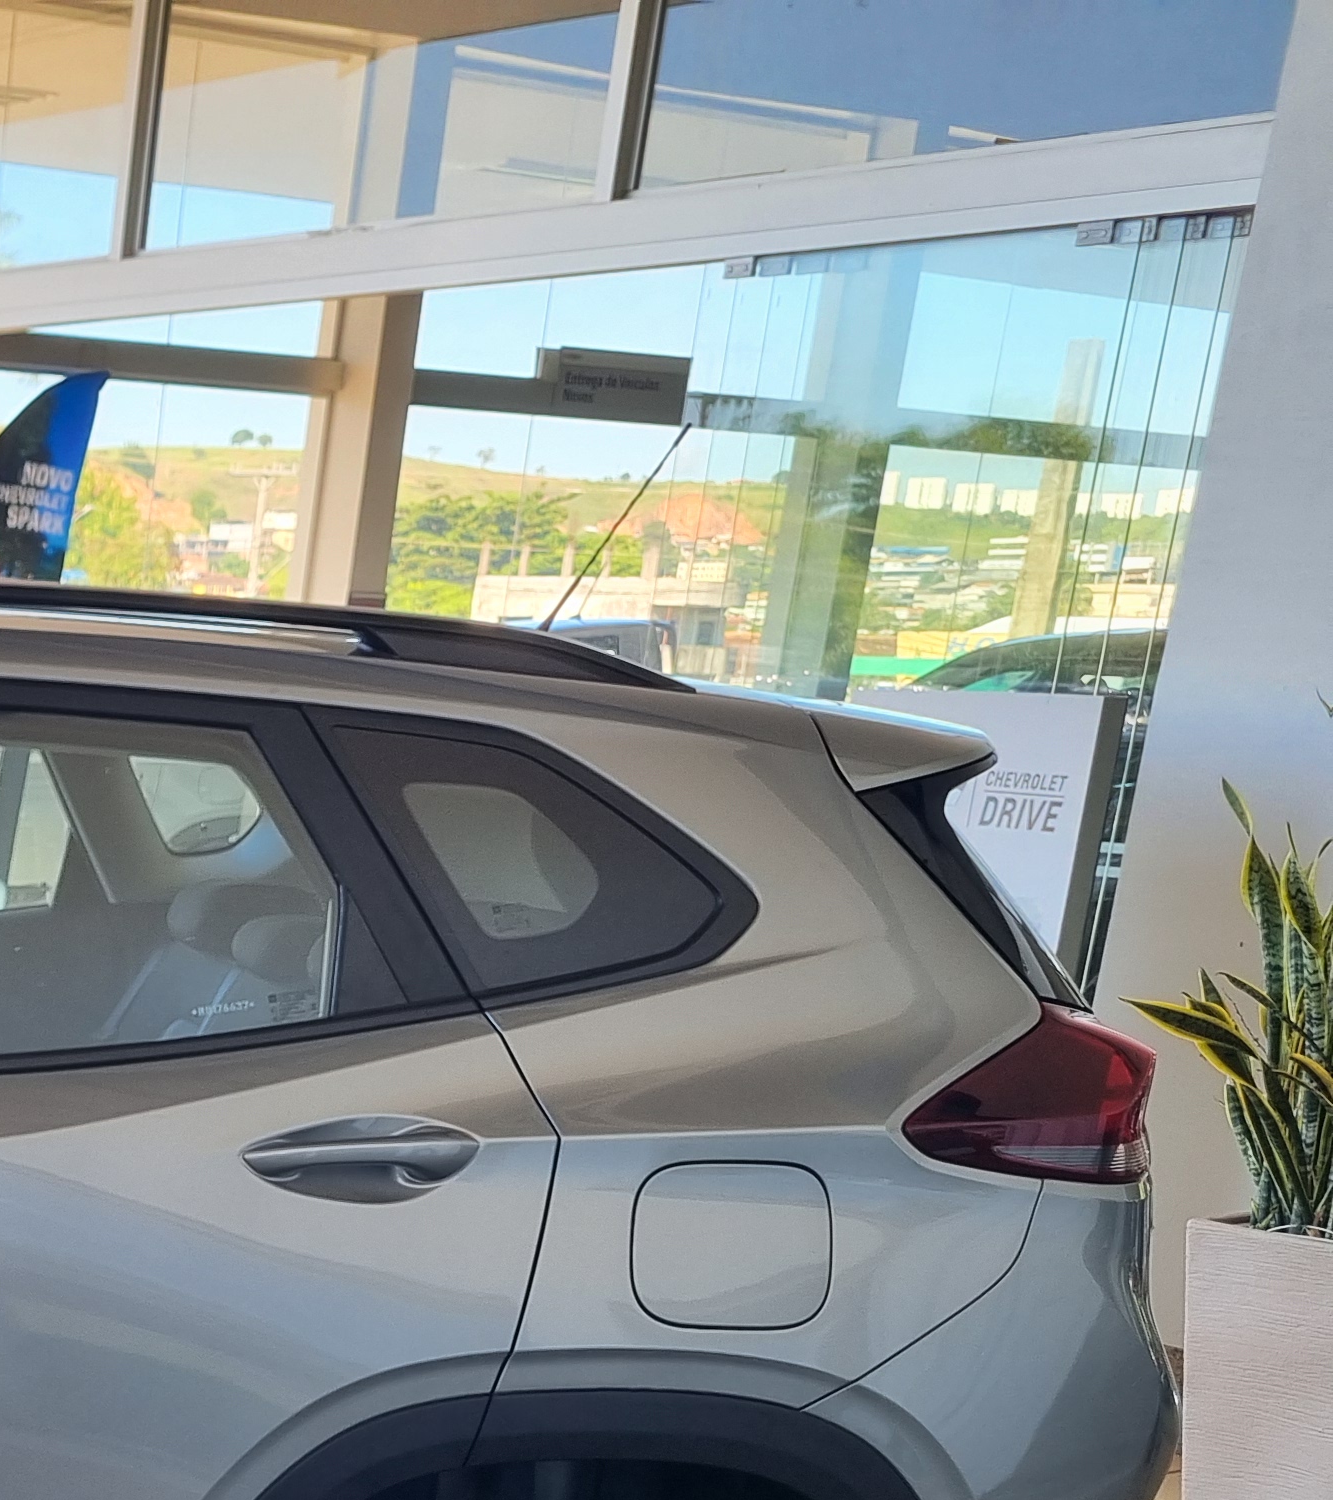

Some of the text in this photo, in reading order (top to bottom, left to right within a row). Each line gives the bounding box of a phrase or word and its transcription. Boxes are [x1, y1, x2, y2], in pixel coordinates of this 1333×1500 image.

[22, 461, 73, 492] NOVO
[7, 505, 65, 533] SPARK
[985, 770, 1069, 793] CHEVROLET
[978, 796, 1063, 833] DRIVE
